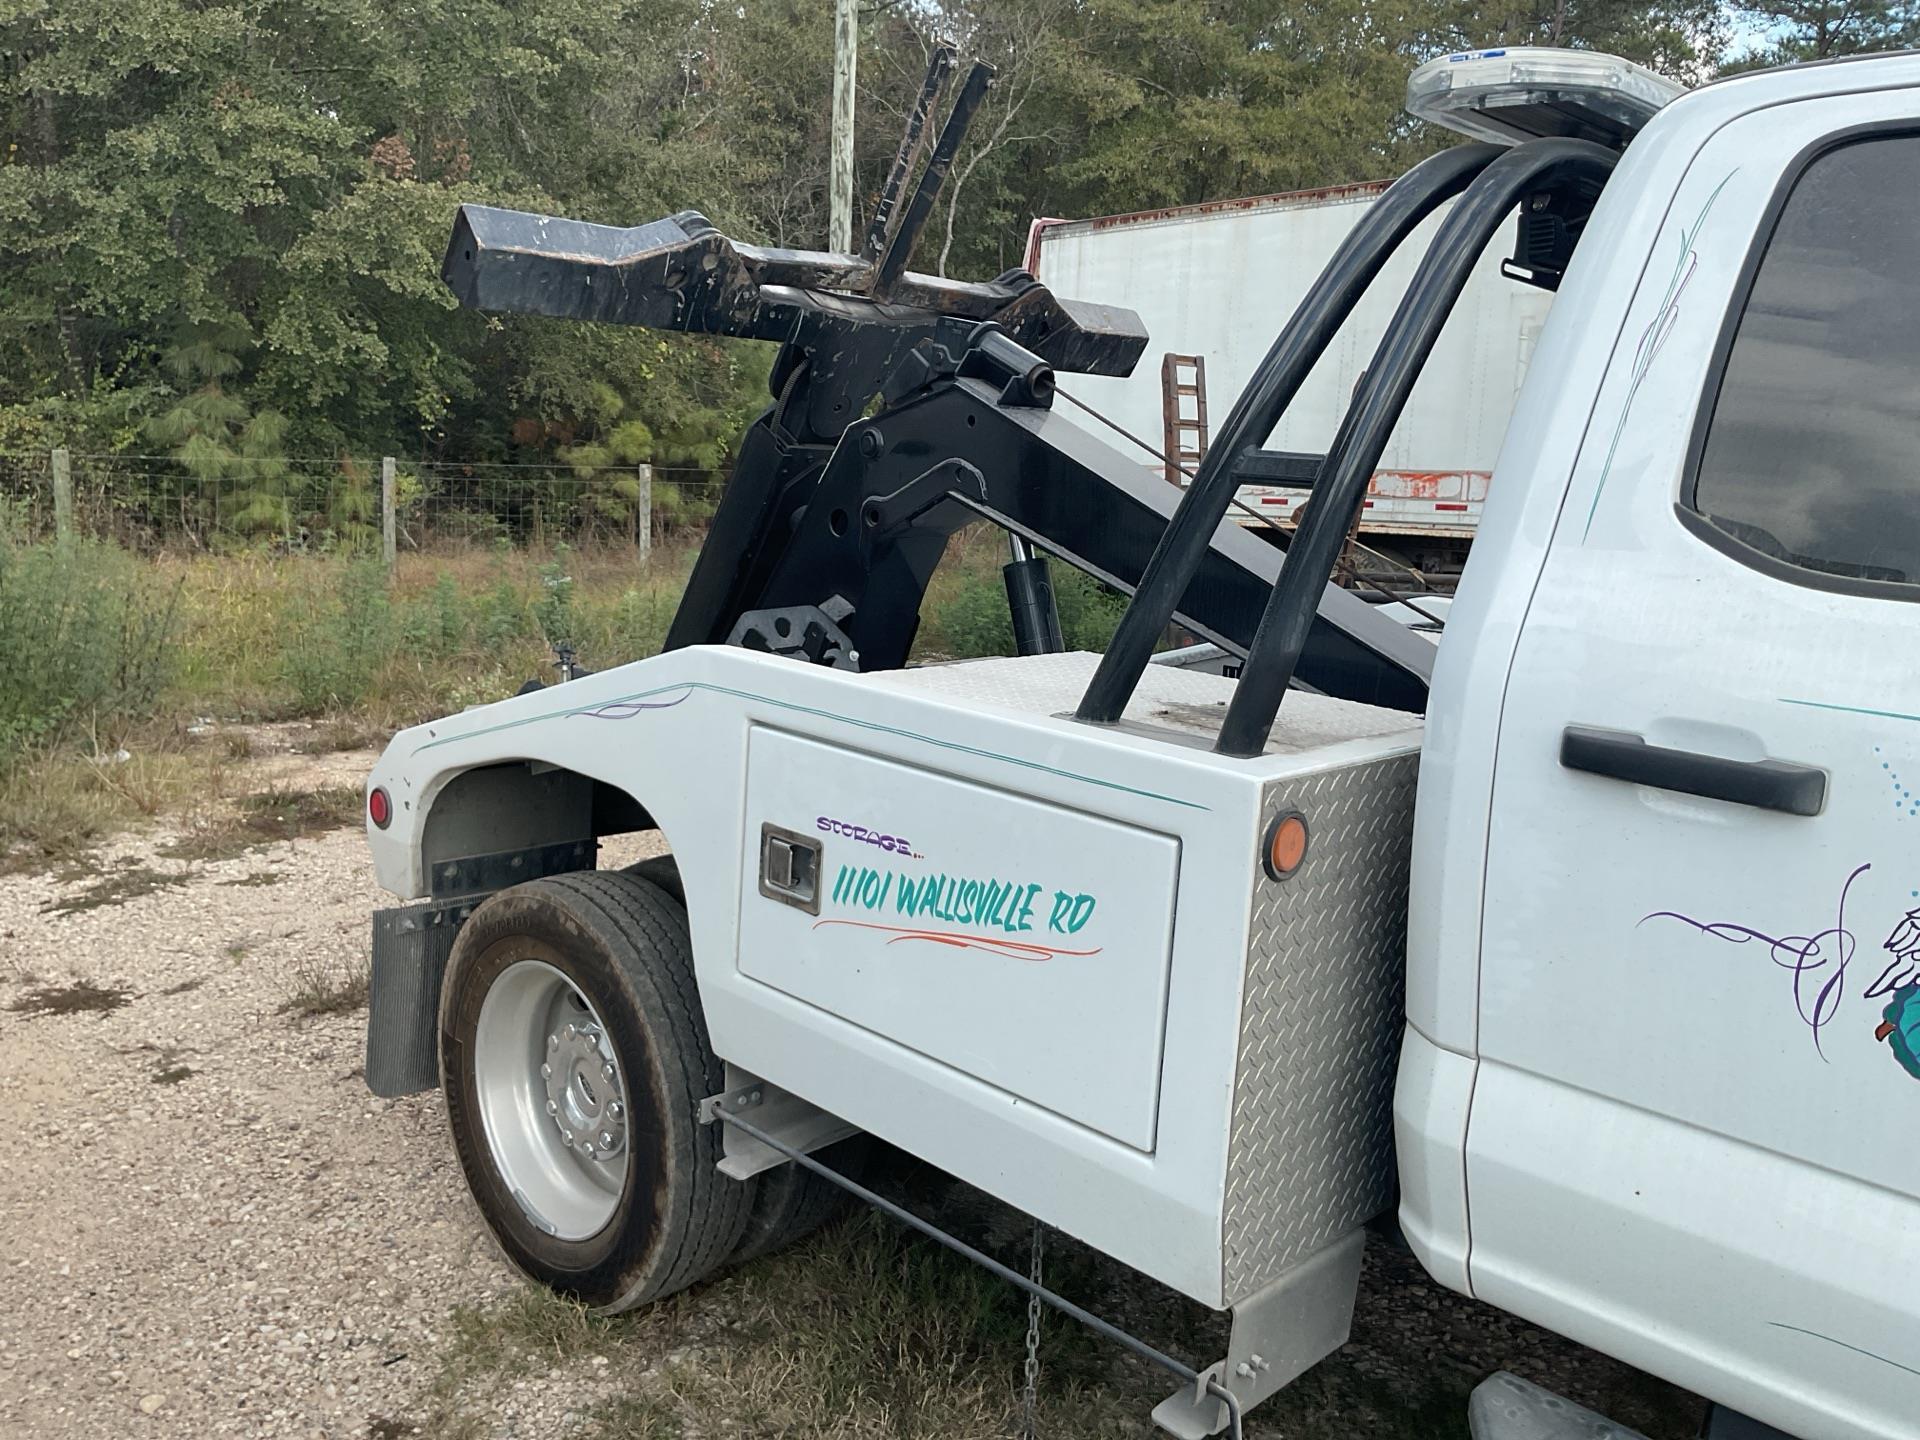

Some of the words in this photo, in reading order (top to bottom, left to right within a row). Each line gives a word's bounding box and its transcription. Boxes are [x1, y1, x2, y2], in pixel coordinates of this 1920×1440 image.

[831, 864, 893, 911] 11101
[896, 872, 1043, 932] WALLISVILLE
[1048, 889, 1097, 935] RD
